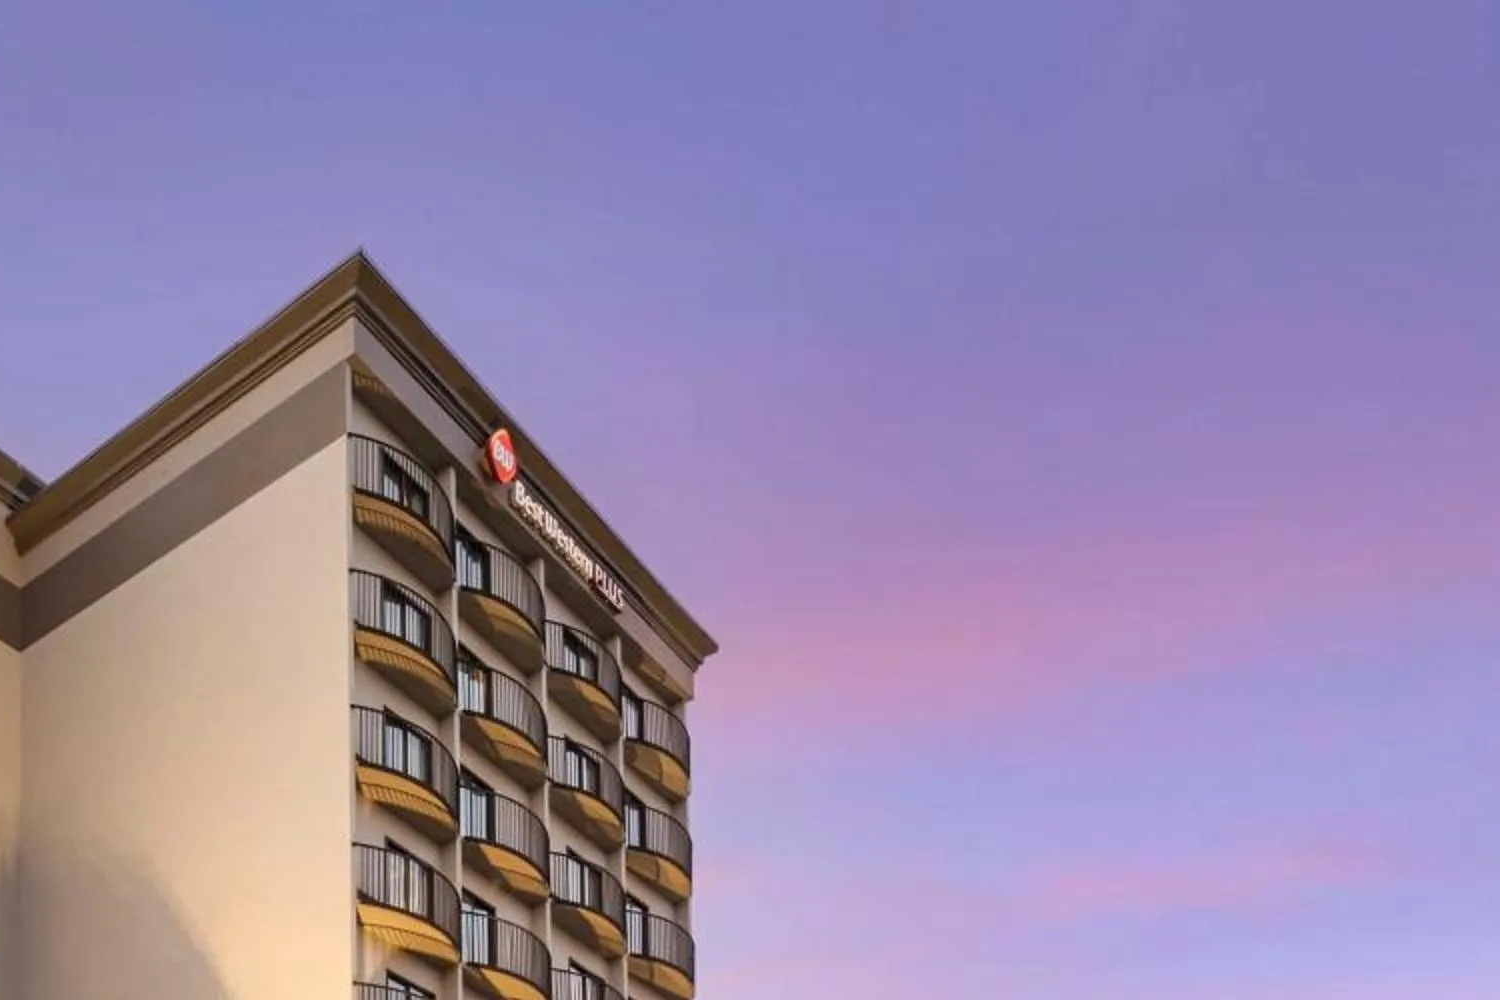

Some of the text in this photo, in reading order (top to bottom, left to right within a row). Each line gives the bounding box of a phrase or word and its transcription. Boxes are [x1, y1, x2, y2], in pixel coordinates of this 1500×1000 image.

[516, 480, 624, 610] Best Western PLUS
